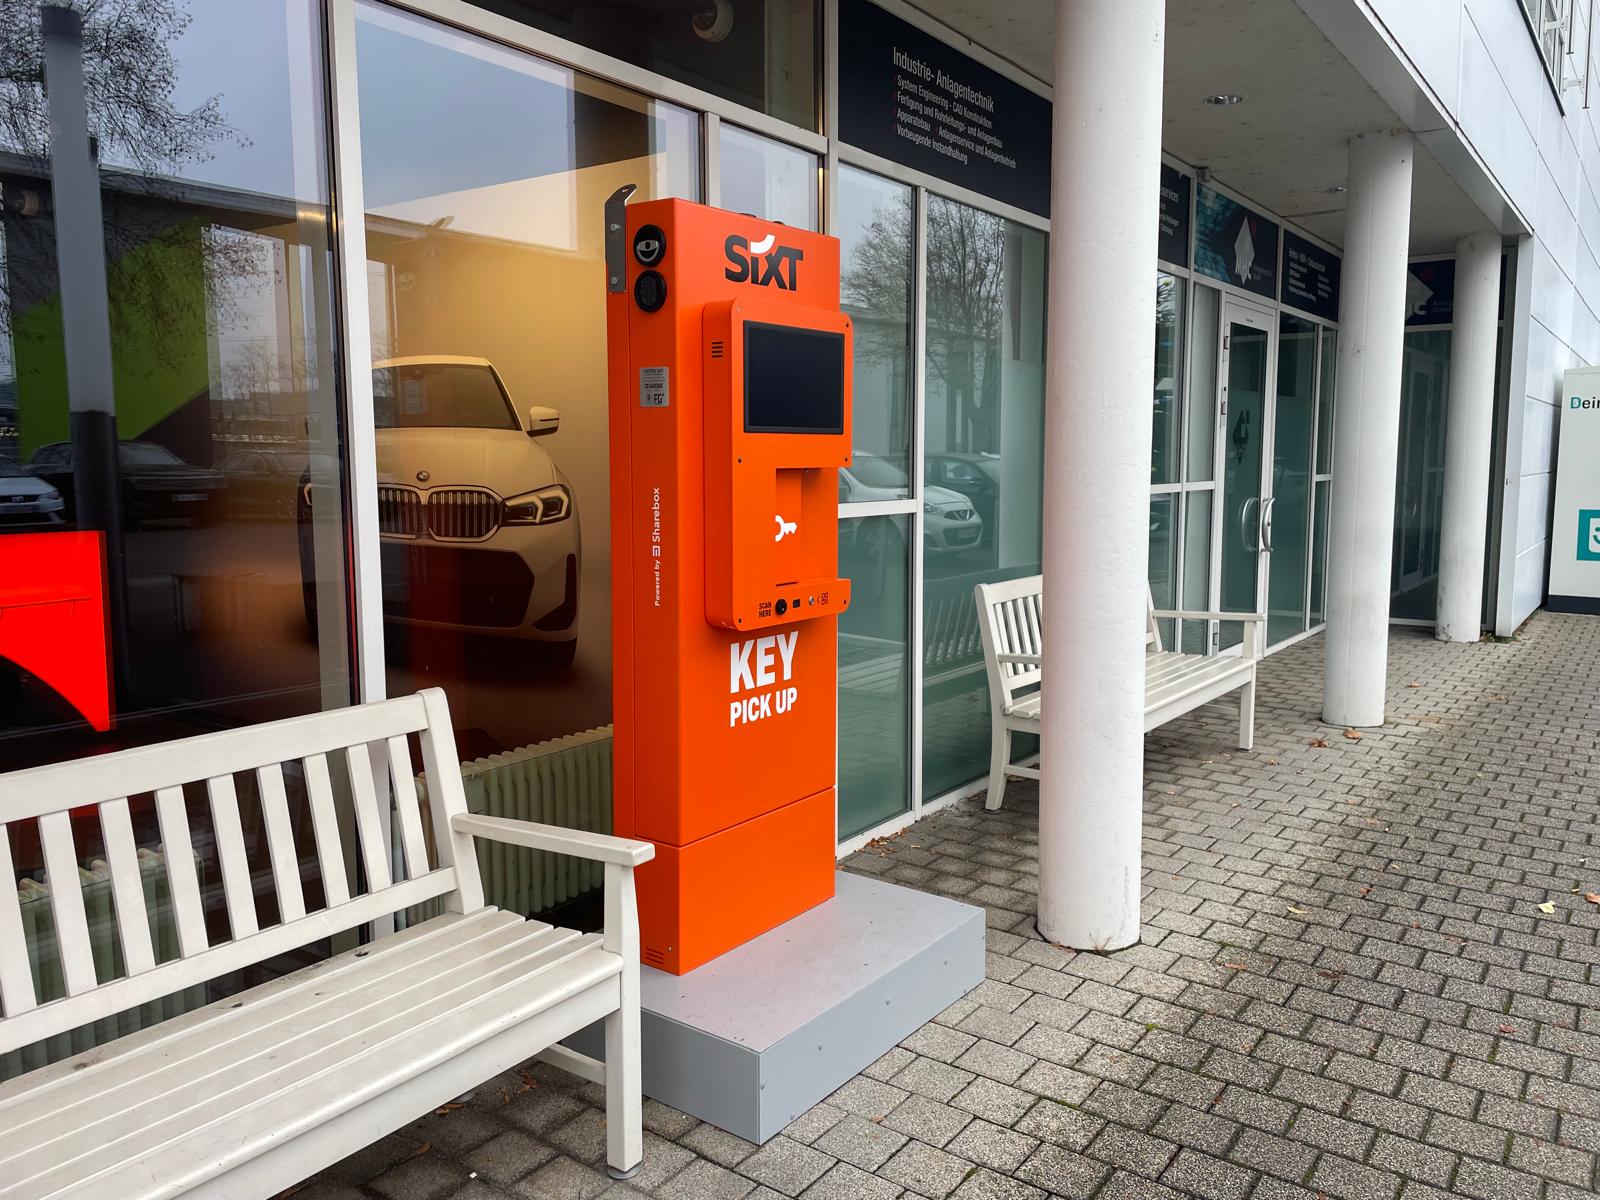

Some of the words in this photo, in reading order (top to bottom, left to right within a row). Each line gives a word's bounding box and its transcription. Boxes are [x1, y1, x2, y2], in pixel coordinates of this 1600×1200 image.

[893, 46, 935, 81] Industrie-
[936, 69, 995, 113] Anlagentechnik
[897, 75, 918, 95] System
[918, 85, 949, 110] Engineering
[897, 107, 931, 131] Apparatebau
[897, 92, 923, 114] Fertigung
[923, 105, 934, 118] und
[967, 124, 977, 137] und
[977, 127, 1003, 149] Anlagenbau
[896, 123, 932, 148] Vorbeugende
[932, 138, 968, 166] Instandhaltung
[938, 125, 975, 151] Anlagenservice
[975, 143, 984, 156] und
[651, 487, 660, 543] Sharebox
[654, 560, 660, 570] by
[758, 601, 772, 610] SCAN
[758, 609, 772, 618] HERE
[730, 631, 799, 694] KEY
[730, 693, 772, 728] PICK
[775, 687, 798, 714] UP
